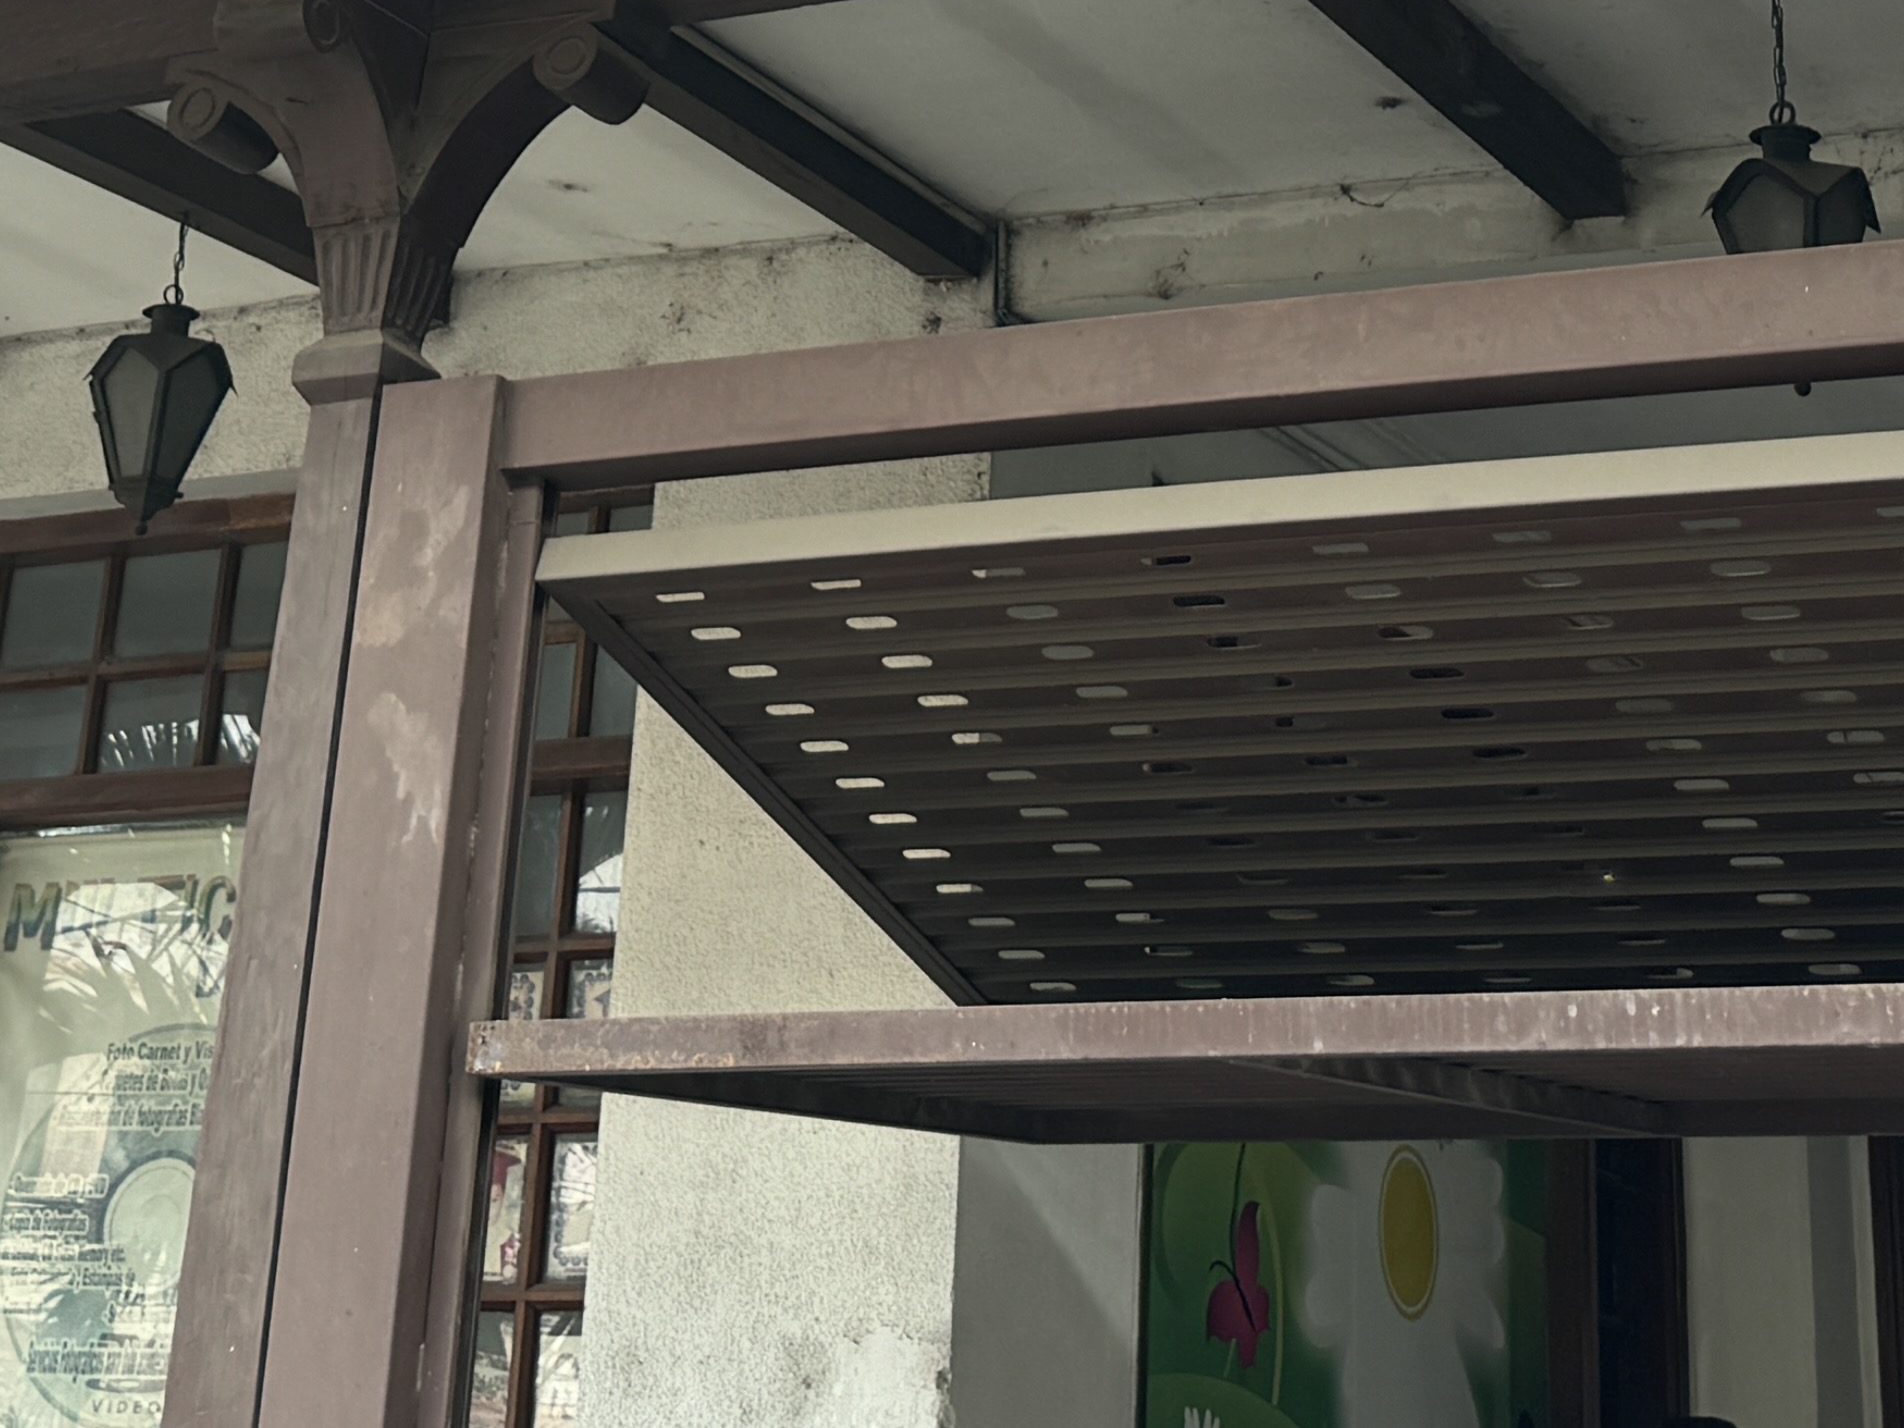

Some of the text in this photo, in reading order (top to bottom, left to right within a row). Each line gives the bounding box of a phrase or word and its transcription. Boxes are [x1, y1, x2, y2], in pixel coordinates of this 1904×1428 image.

[107, 1042, 135, 1061] Foto
[138, 1040, 181, 1060] Carnet
[92, 1398, 162, 1416] VIDEO
